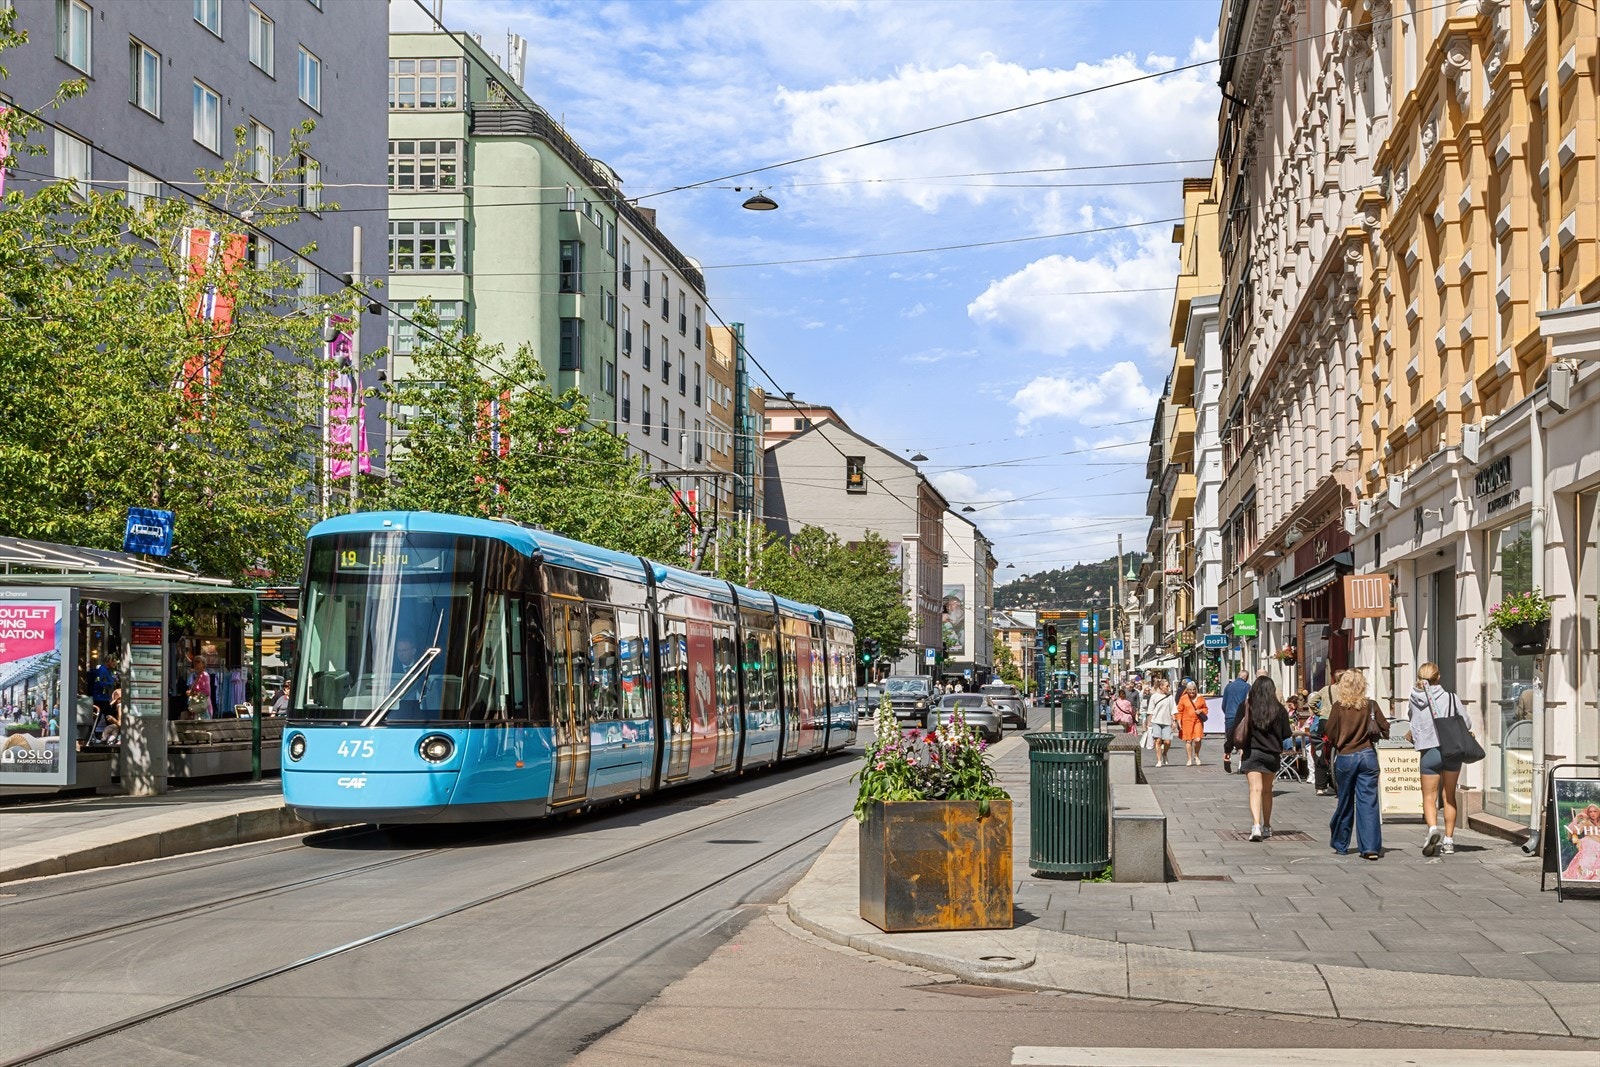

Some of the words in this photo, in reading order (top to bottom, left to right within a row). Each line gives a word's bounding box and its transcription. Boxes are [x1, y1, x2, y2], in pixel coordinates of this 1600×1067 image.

[340, 550, 356, 566] 19
[1114, 641, 1120, 649] P
[1206, 636, 1227, 644] norli
[337, 740, 374, 758] 475
[18, 749, 54, 760] OSLO
[337, 778, 368, 788] CAF
